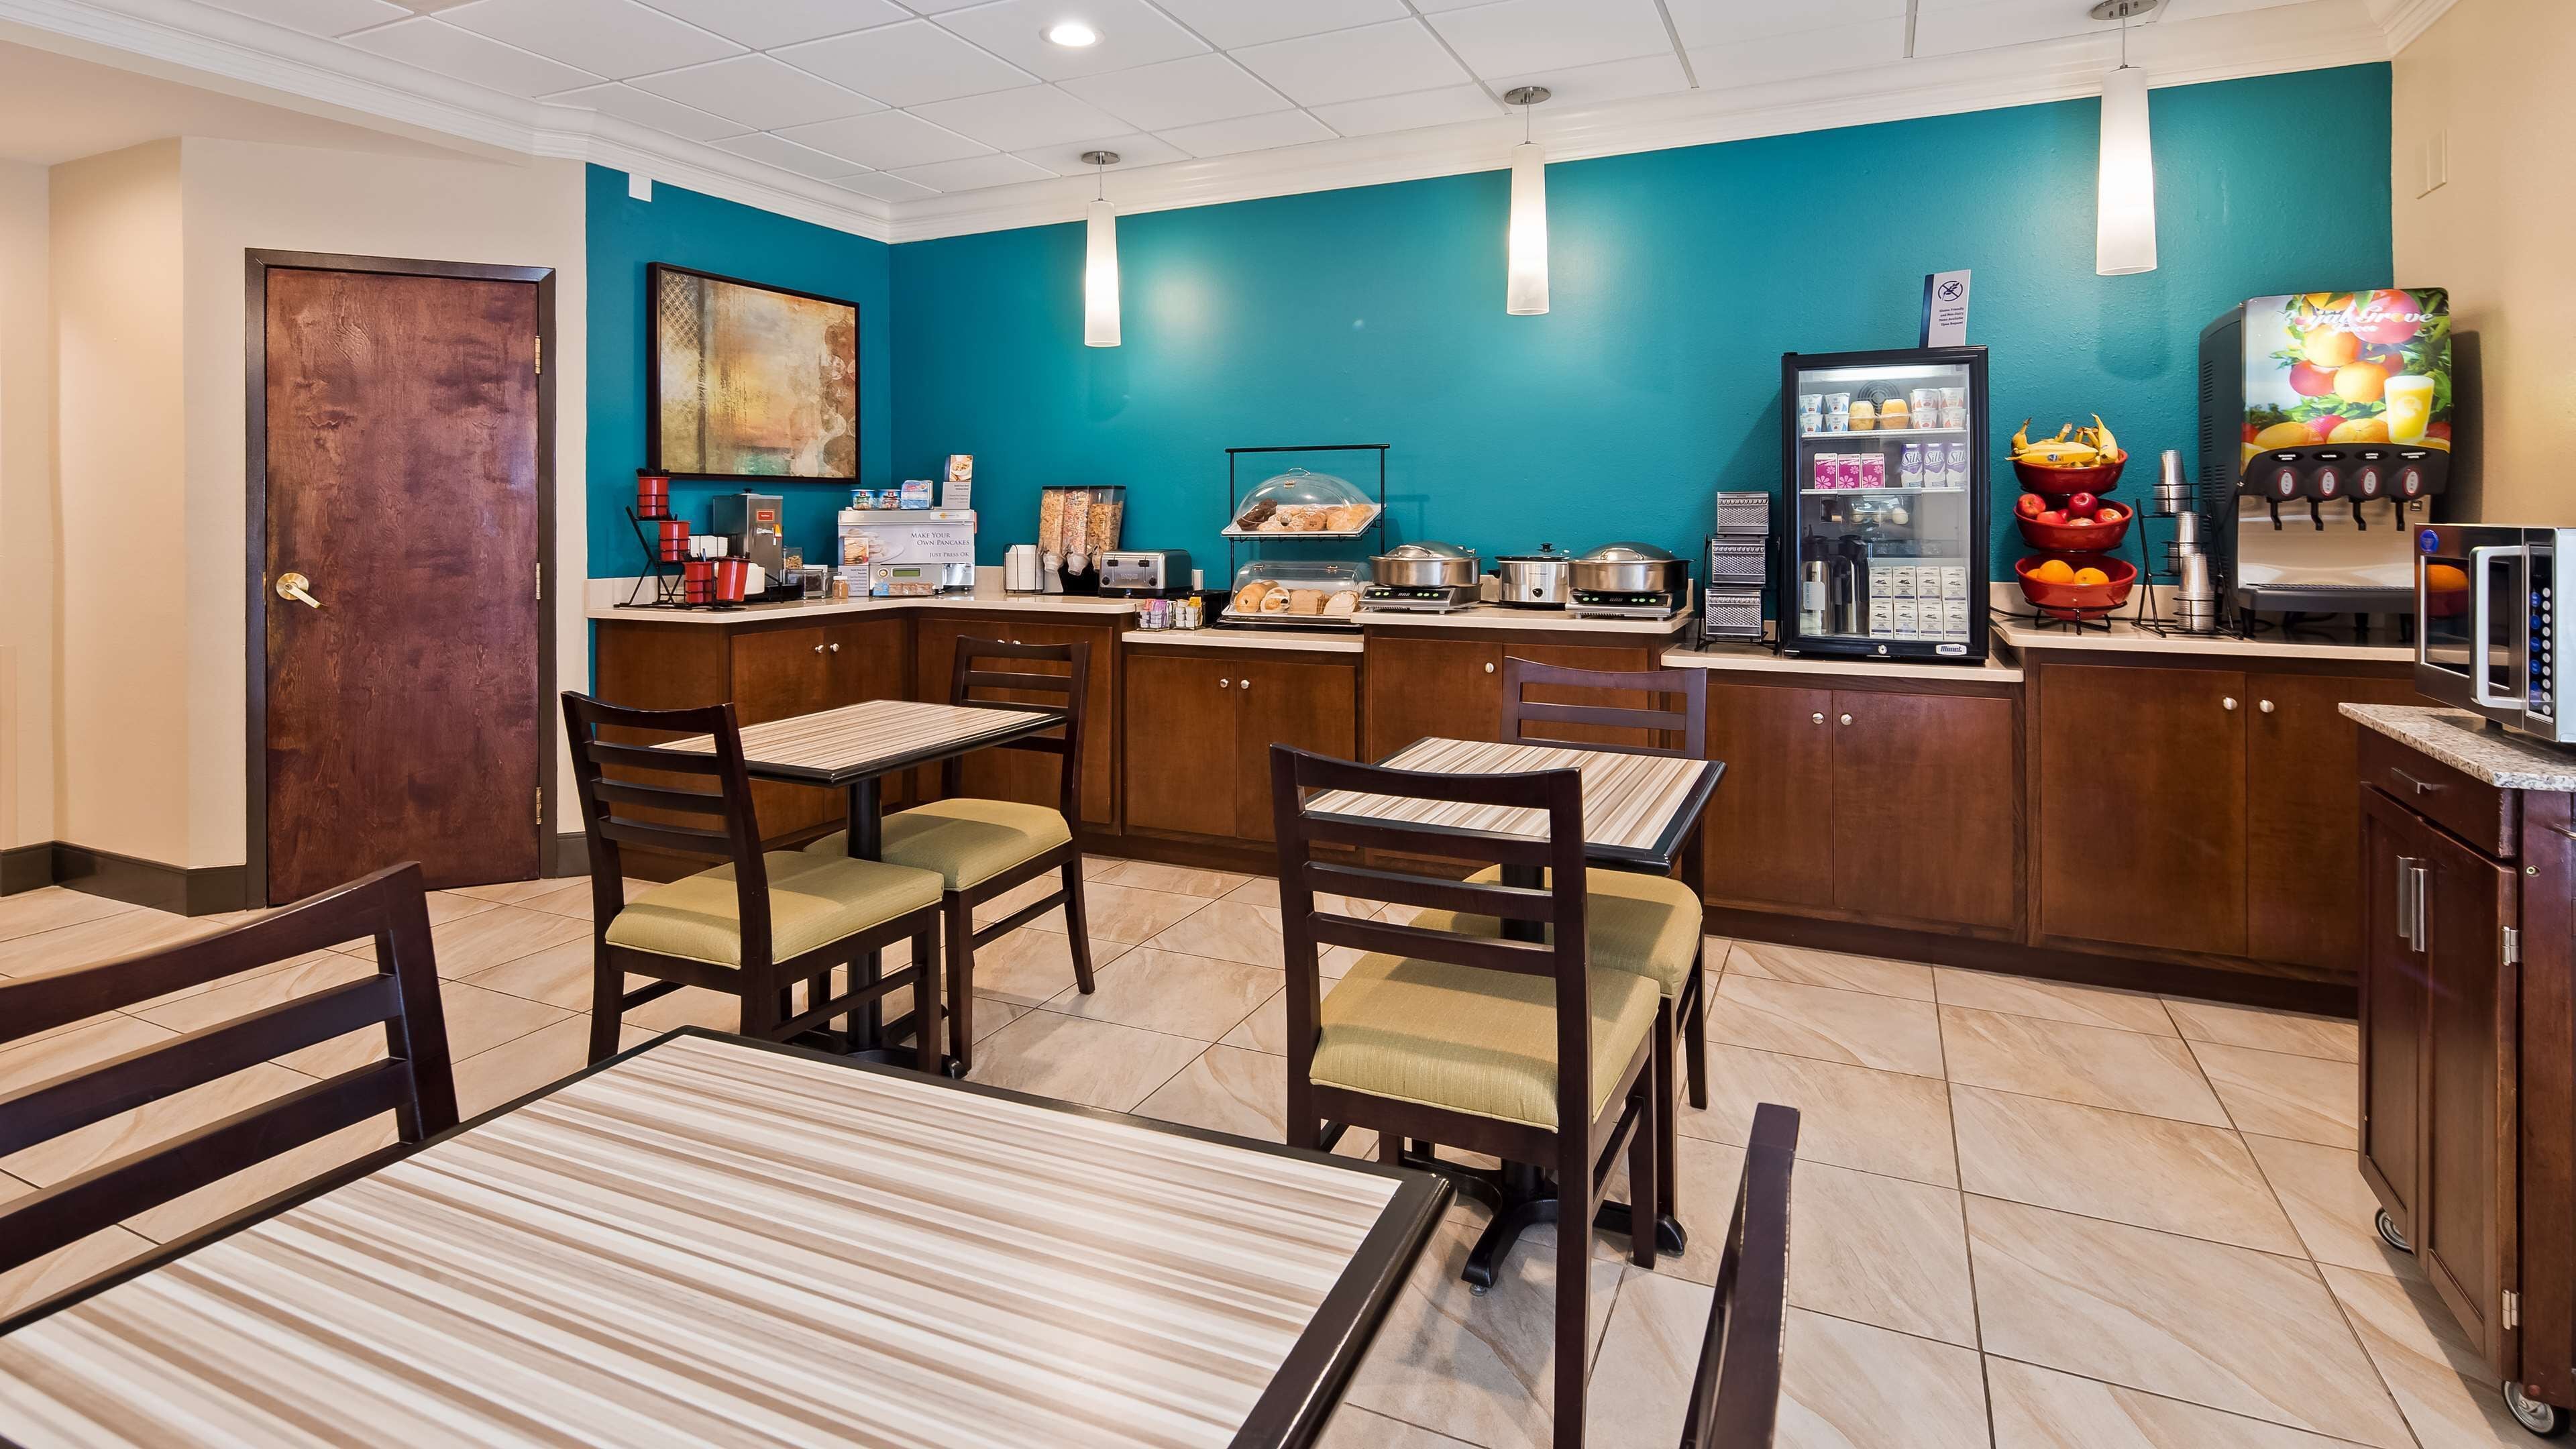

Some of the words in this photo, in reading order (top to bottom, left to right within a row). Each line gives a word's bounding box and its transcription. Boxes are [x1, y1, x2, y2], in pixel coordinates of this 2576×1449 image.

[1902, 451, 1921, 466] Silk
[1924, 451, 1944, 466] Silk
[1947, 450, 1966, 465] Silk
